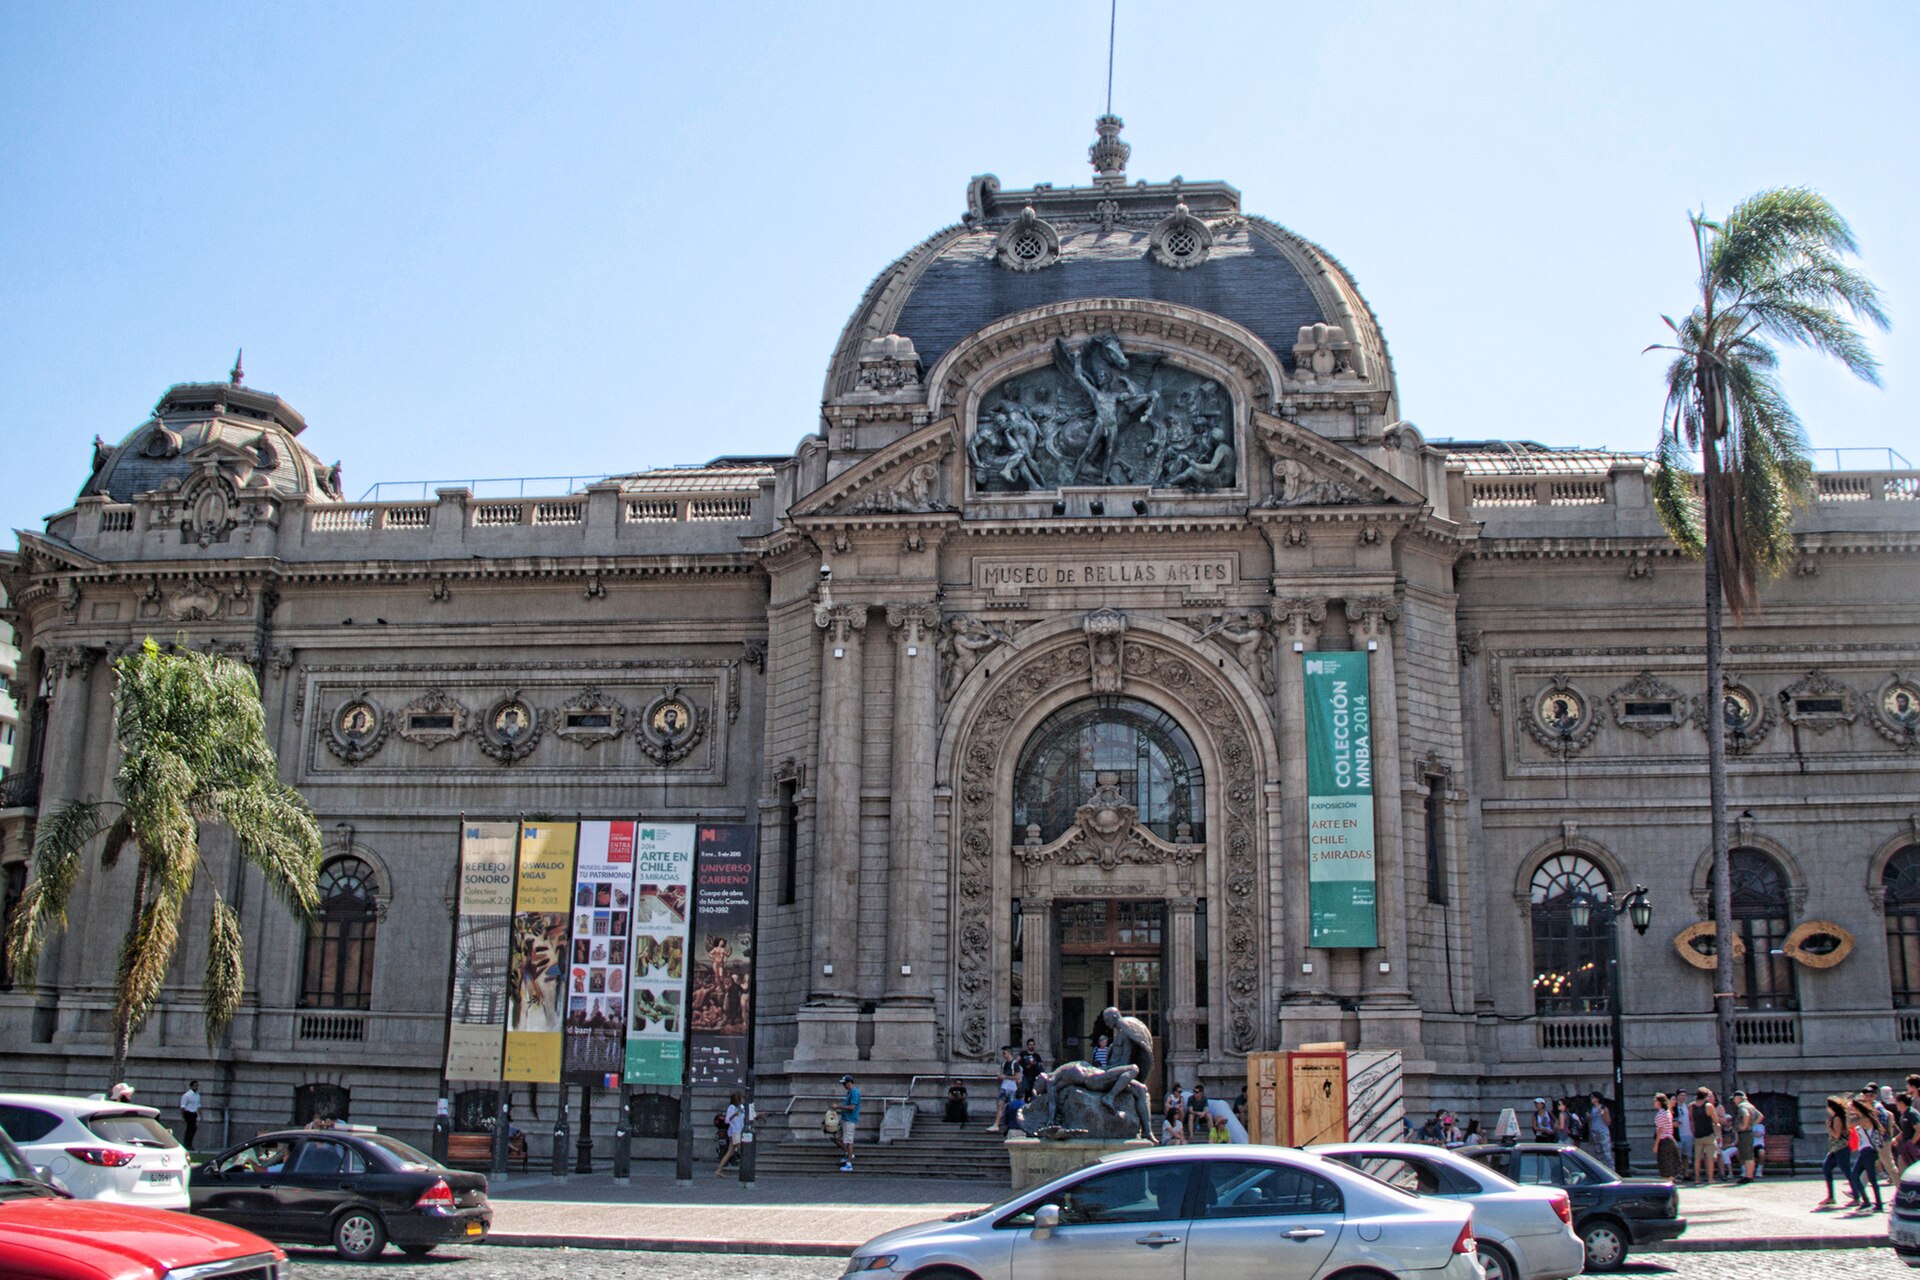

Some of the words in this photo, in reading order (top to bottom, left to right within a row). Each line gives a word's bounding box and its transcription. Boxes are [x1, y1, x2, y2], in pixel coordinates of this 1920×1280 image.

[985, 567, 1048, 584] MUSEO
[1057, 569, 1076, 583] DE
[1084, 565, 1155, 582] BELLAS
[1167, 564, 1226, 581] ARTES
[1353, 694, 1368, 733] 2014
[1329, 681, 1351, 788] COLECCIÓN
[1354, 735, 1370, 787] MNBA
[1311, 801, 1357, 810] EXPOSICIÓN
[1311, 820, 1340, 829] ARTE
[1342, 819, 1357, 828] EN
[1311, 835, 1348, 844] CHILE:
[640, 851, 670, 861] ARTE
[672, 852, 688, 861] EN
[1312, 853, 1318, 862] 3
[1320, 850, 1372, 860] MIRADAS
[465, 862, 506, 873] REFLEJO
[640, 862, 677, 872] CHILE:
[700, 863, 752, 873] UNIVERSO
[464, 874, 510, 884] SONORO
[521, 871, 546, 879] VIGAS
[589, 871, 631, 879] PATRIMONIO
[640, 873, 644, 881] 3
[645, 873, 680, 881] MIRADAS
[464, 887, 497, 895] Colectivo
[699, 889, 721, 897] Cuerpo
[497, 897, 511, 905] 2.0
